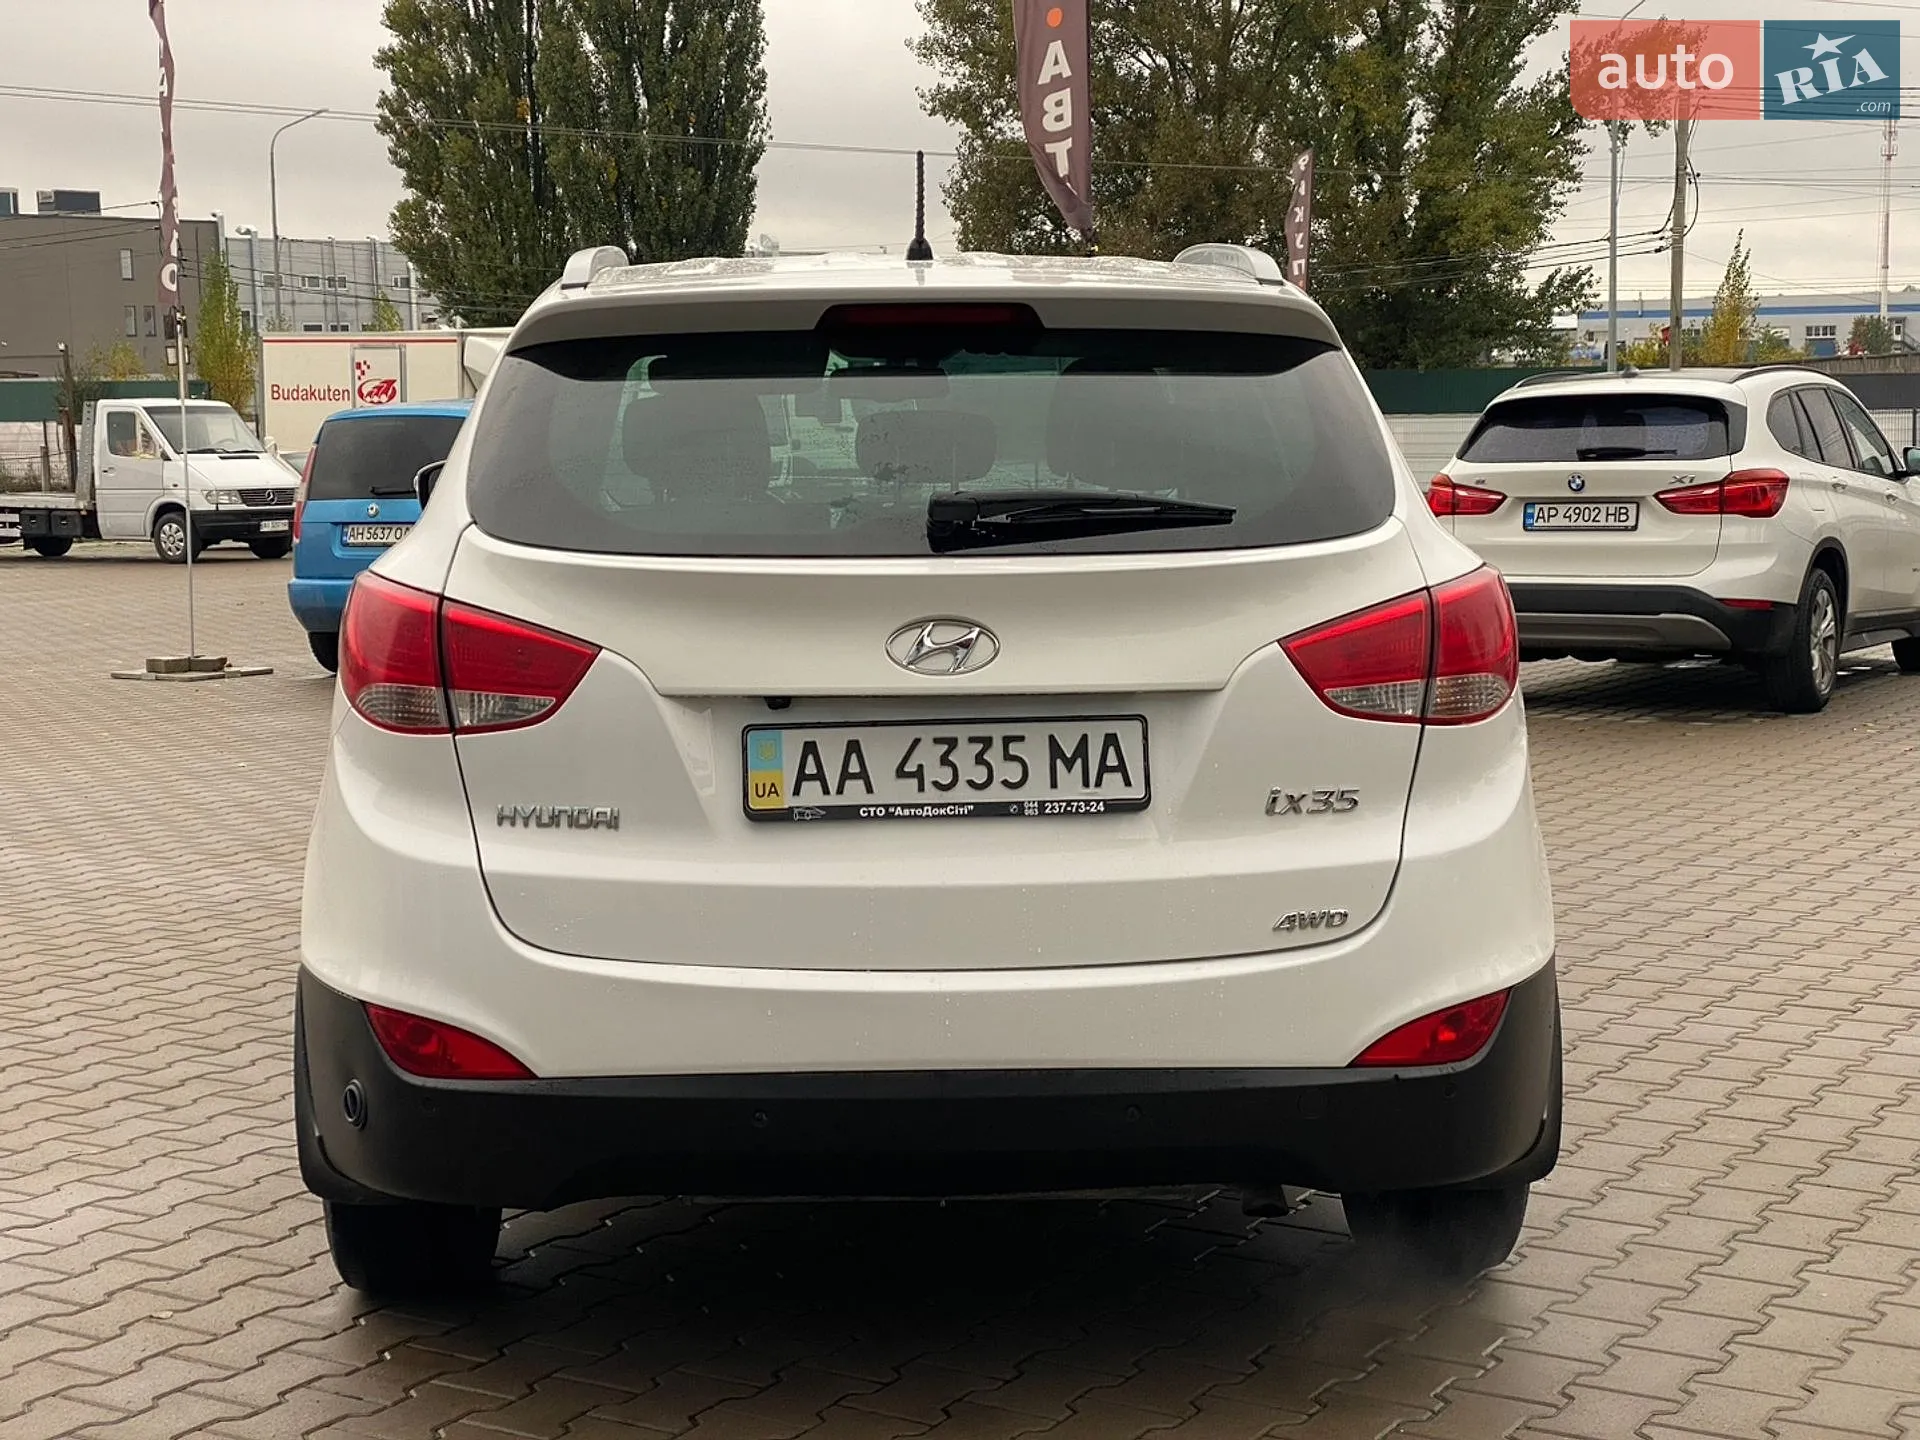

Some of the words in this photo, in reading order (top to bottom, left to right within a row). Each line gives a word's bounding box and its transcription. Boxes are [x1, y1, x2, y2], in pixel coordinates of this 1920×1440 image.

[271, 384, 350, 401] Budakuten
[1668, 473, 1697, 484] X1
[1534, 506, 1559, 523] AP
[1563, 506, 1601, 523] 4902
[1605, 506, 1630, 523] HB
[348, 527, 364, 541] AH
[366, 527, 392, 541] 5637
[792, 739, 874, 796] AA
[895, 734, 1029, 793] 4335
[1048, 732, 1132, 789] MA
[755, 783, 780, 798] UA
[1044, 801, 1105, 814] 237-73-24
[1264, 786, 1360, 816] ix35
[496, 804, 620, 831] HYUNDAI
[860, 806, 886, 817] СТО
[1272, 909, 1349, 931] 4WD
